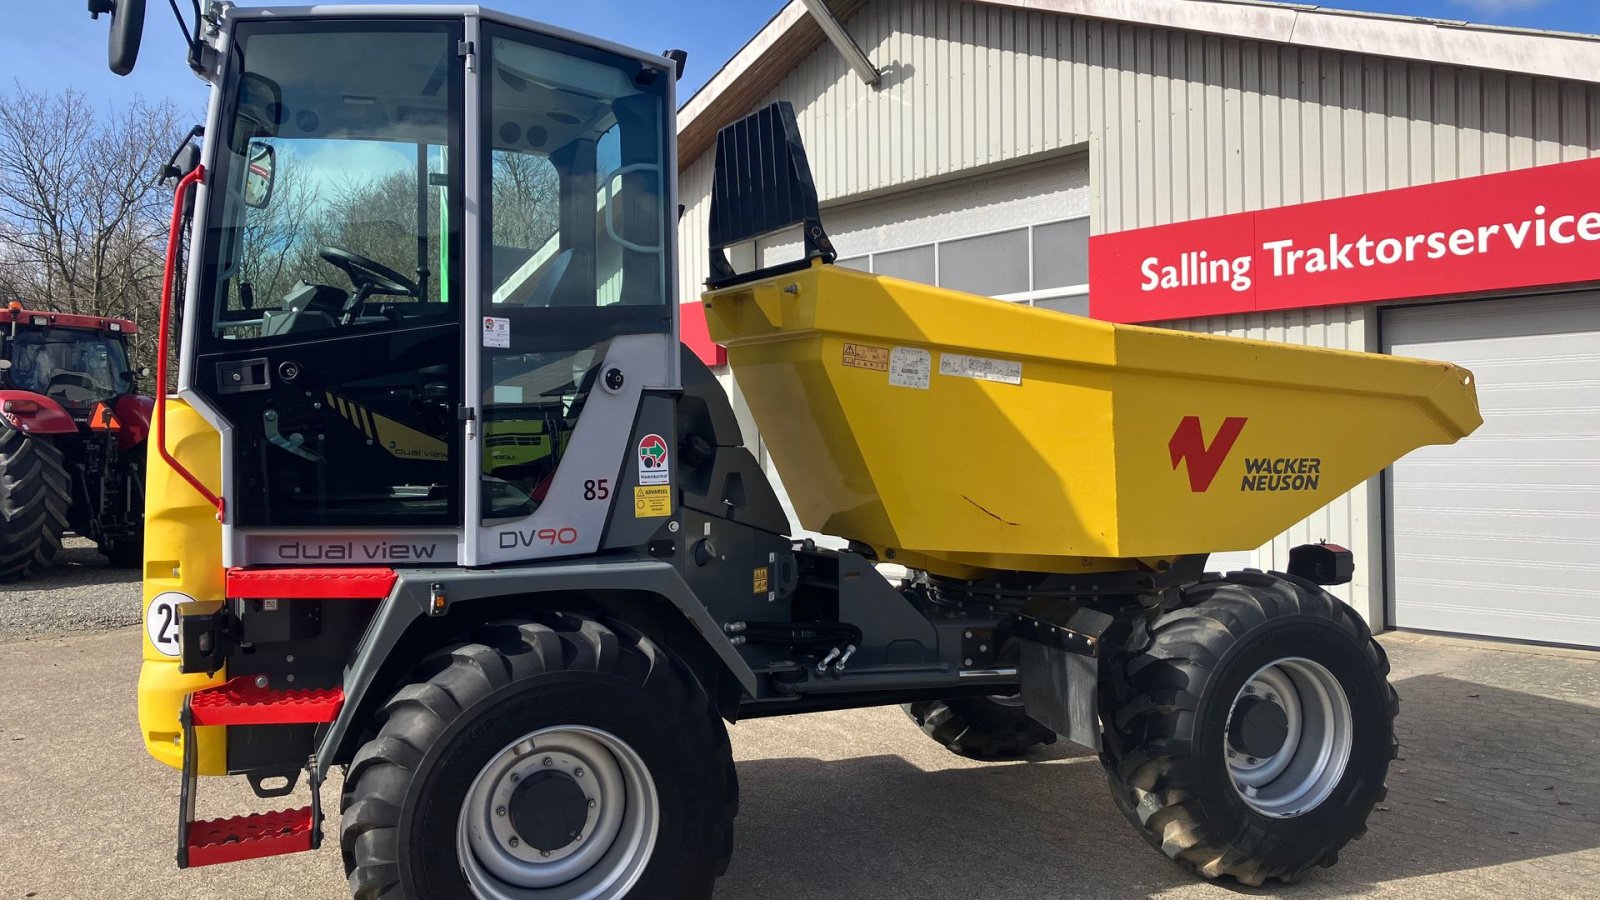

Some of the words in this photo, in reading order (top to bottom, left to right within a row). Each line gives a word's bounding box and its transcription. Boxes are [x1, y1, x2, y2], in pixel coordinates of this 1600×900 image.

[1141, 250, 1252, 292] Salling
[1263, 204, 1600, 277] Traktorservice
[1245, 458, 1321, 474] WACKER
[583, 479, 609, 501] 85
[1241, 475, 1319, 491] NEUSON
[499, 527, 577, 549] DV90
[278, 541, 352, 560] dual
[362, 541, 437, 559] view
